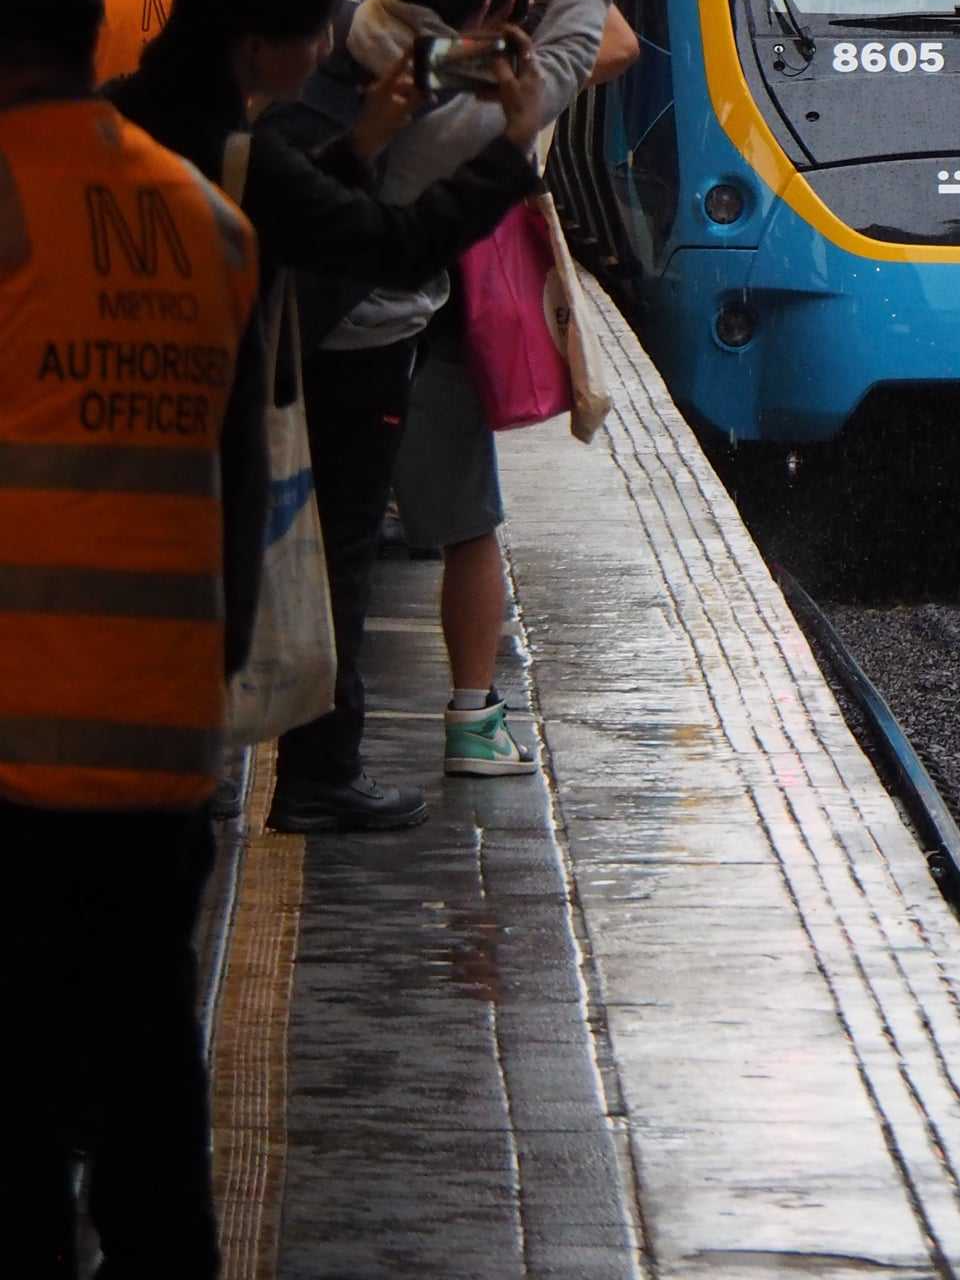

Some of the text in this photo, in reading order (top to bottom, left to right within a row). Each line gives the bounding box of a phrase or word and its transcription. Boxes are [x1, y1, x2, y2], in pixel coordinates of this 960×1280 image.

[832, 42, 945, 73] 8605
[98, 290, 198, 322] METRO
[80, 389, 208, 434] OFFICER
